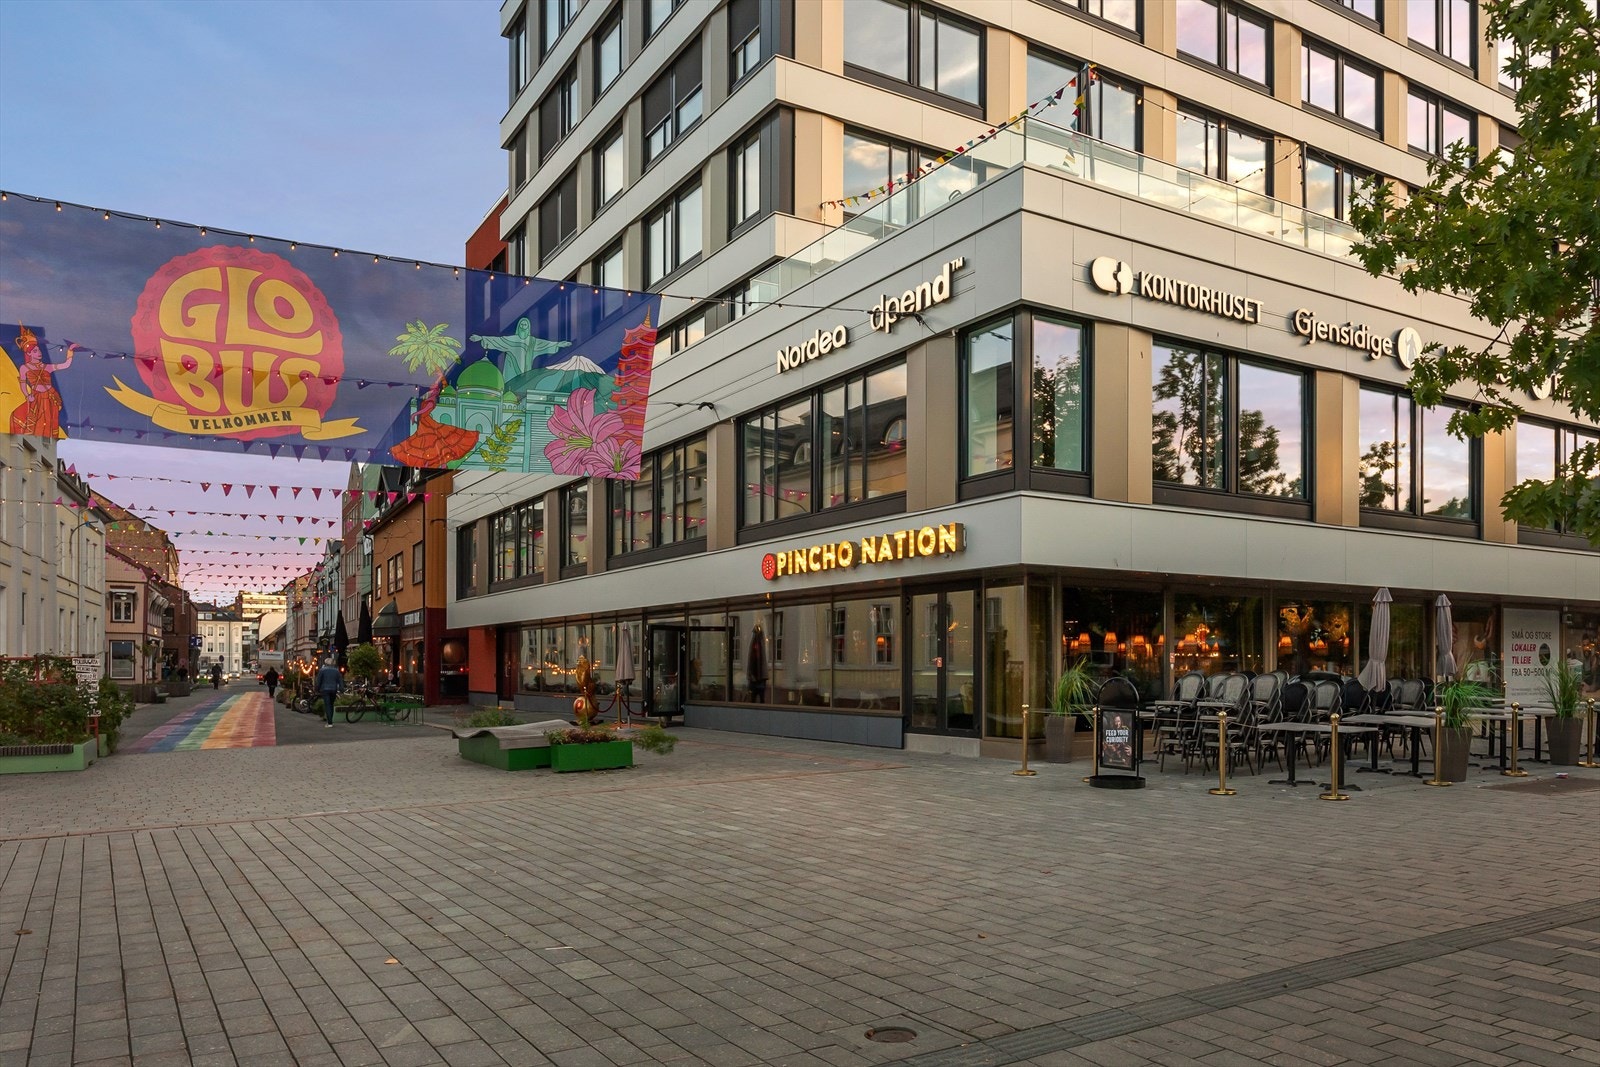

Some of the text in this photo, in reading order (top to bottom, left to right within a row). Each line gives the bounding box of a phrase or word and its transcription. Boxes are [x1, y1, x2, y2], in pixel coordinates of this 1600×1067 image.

[1139, 270, 1264, 324] KONTORHUSET
[1294, 307, 1394, 360] Gjensidige
[776, 325, 848, 374] Nordea
[189, 410, 292, 430] VELKOMMEN
[776, 521, 958, 577] PINCHO NATION
[196, 638, 202, 646] P
[1511, 628, 1552, 640] SMÅ OG STORE
[1511, 643, 1537, 652] LOKALER
[1511, 656, 1532, 664] TIL LEIE
[1511, 668, 1522, 677] FRA
